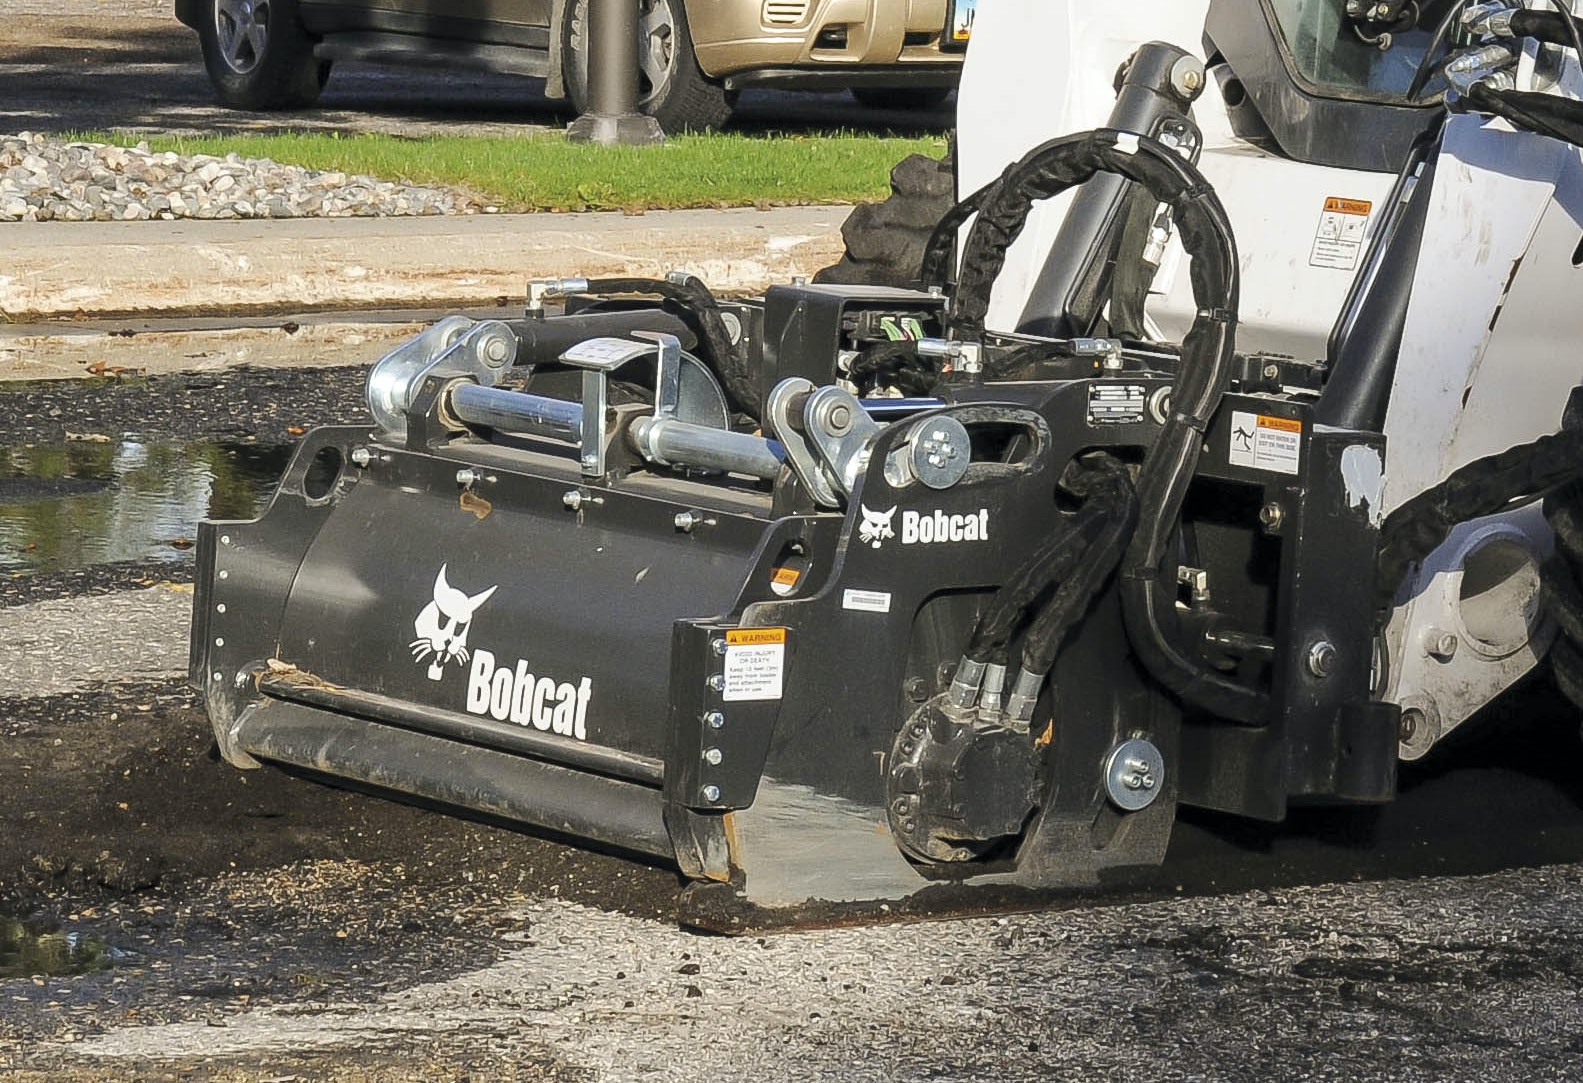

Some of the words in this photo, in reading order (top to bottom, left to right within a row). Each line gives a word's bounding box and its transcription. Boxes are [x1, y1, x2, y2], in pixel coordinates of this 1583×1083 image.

[902, 509, 989, 544] Bobcat
[741, 634, 781, 642] WARNING
[466, 648, 592, 740] Bobcat
